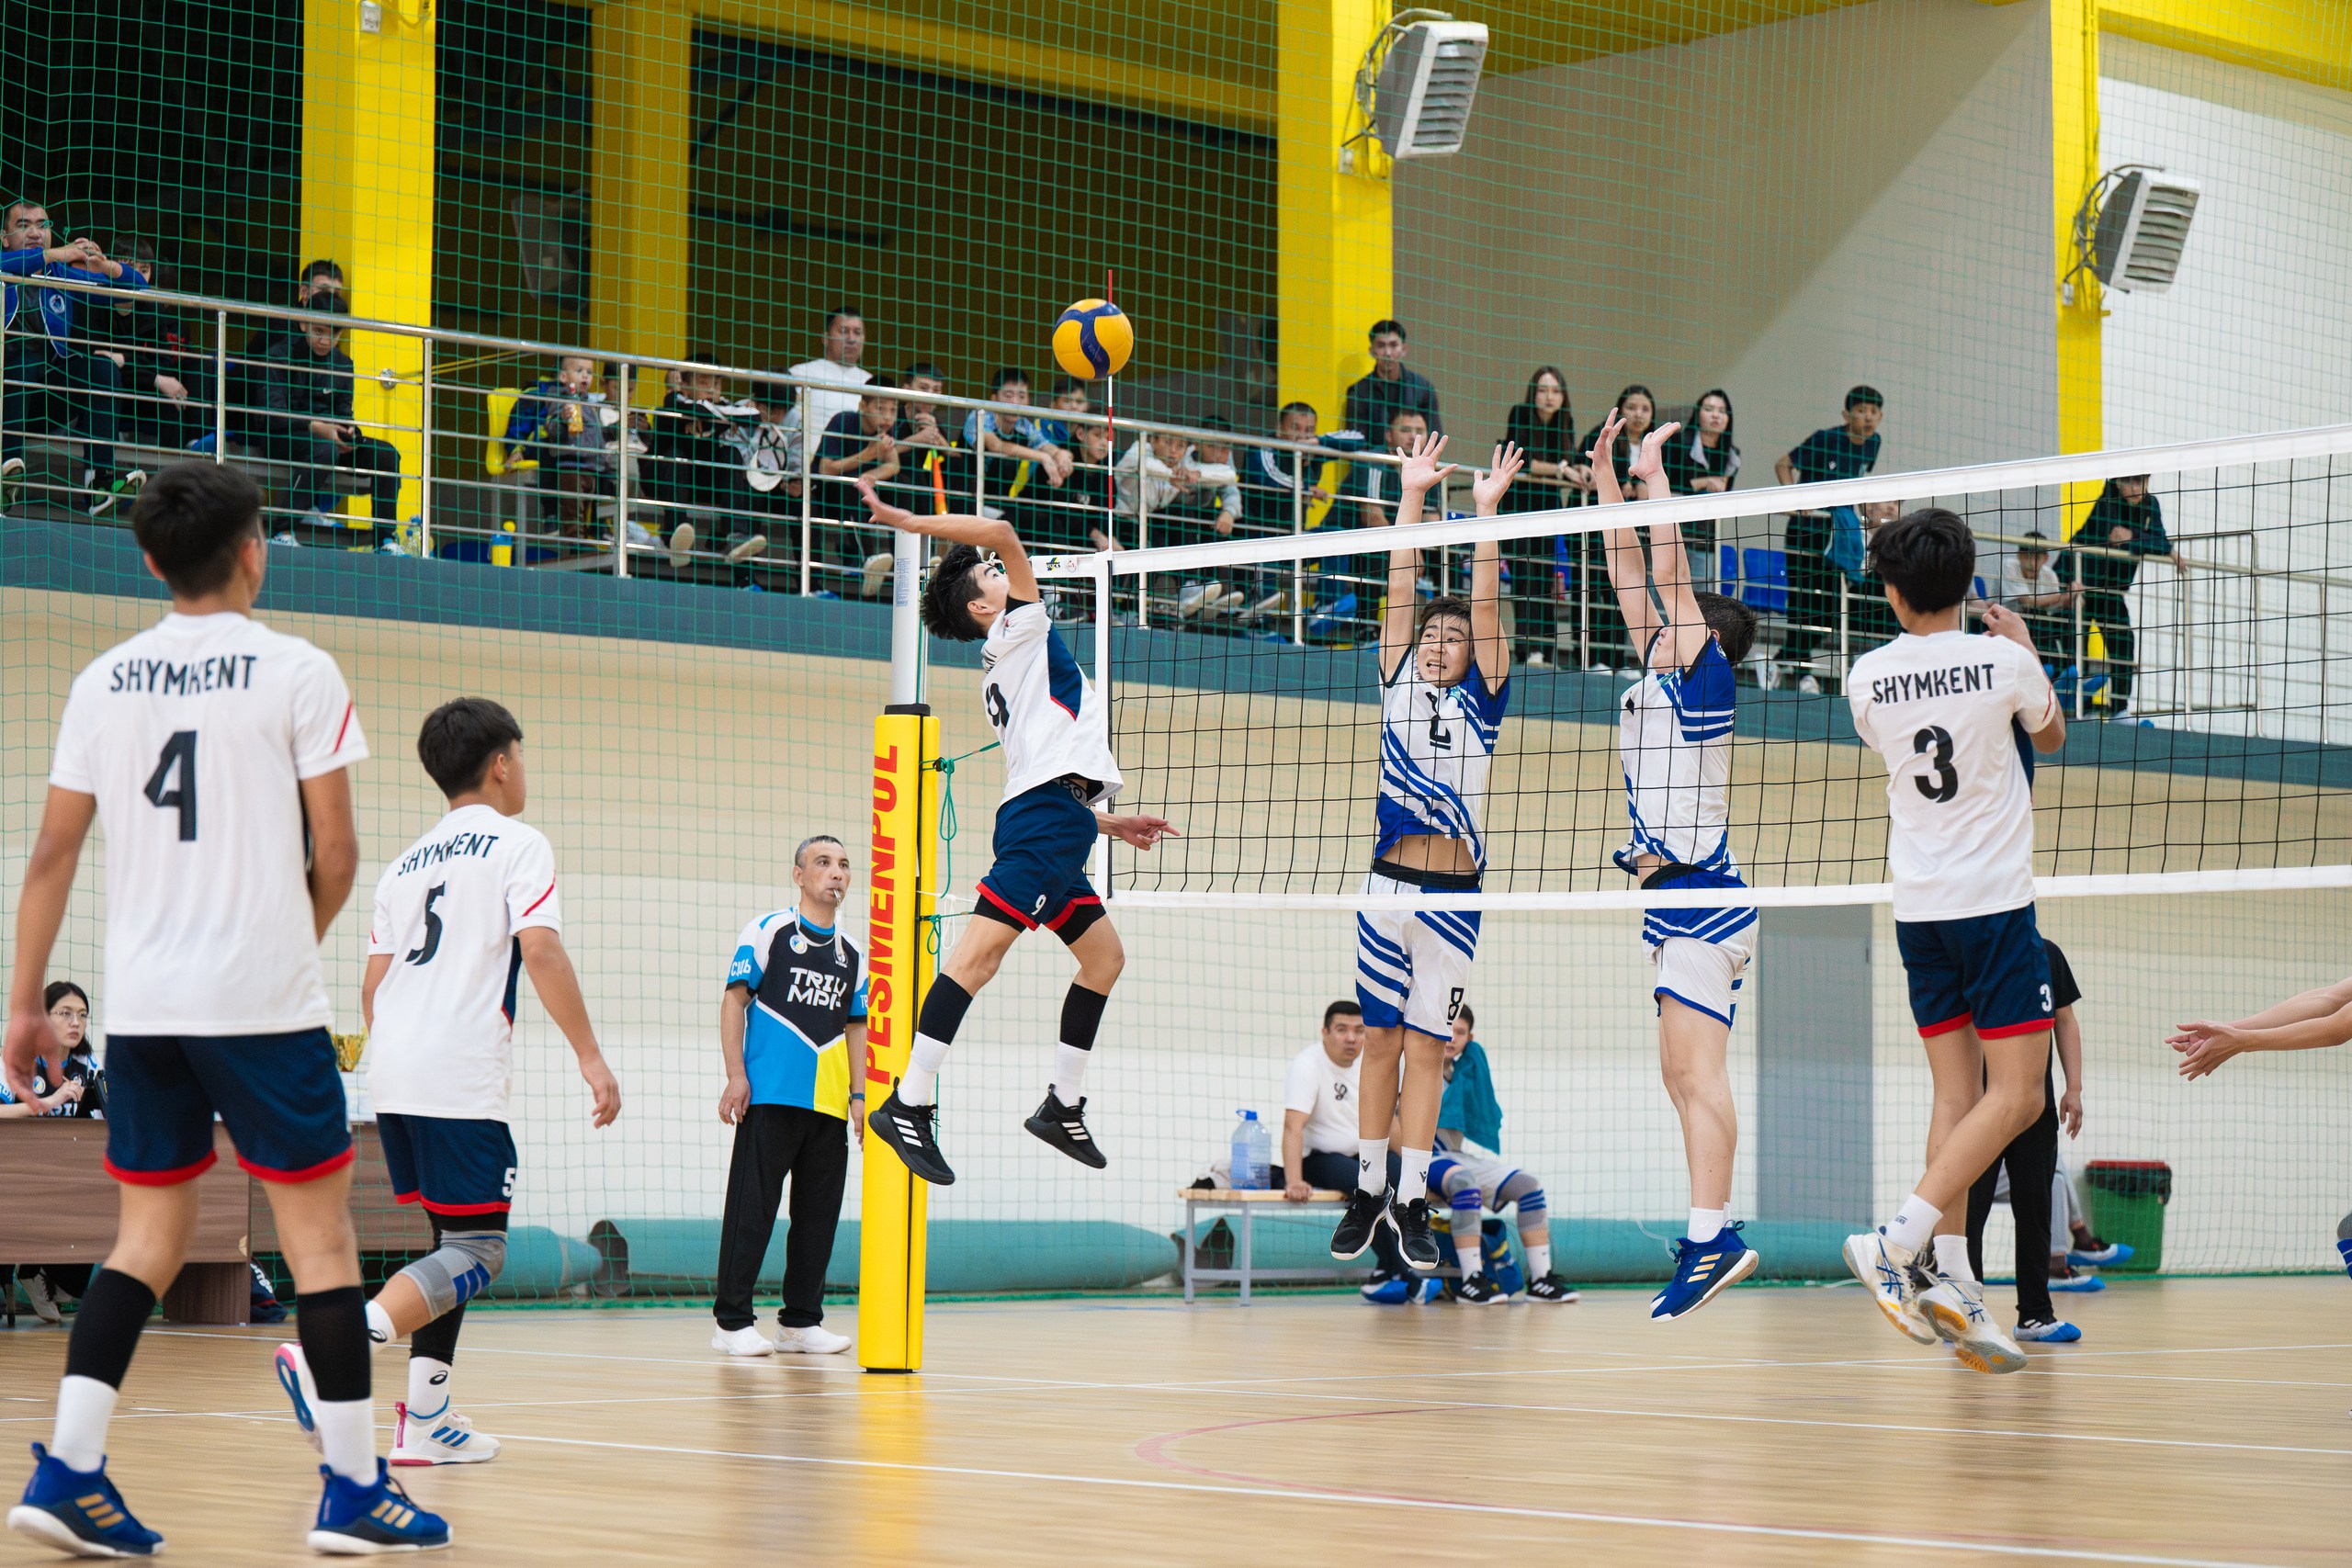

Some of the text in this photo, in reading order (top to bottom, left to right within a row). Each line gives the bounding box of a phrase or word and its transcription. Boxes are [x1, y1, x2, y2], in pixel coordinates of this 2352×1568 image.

[110, 655, 256, 696] SHYMKENT
[1872, 663, 1994, 705] SHYMKENT
[1914, 725, 1959, 803] 3
[143, 730, 197, 841] 4
[405, 881, 446, 965] 5
[1031, 894, 1046, 916] 9
[1446, 987, 1464, 1022] 8
[2040, 984, 2052, 1012] 3
[503, 1168, 515, 1198] 5
